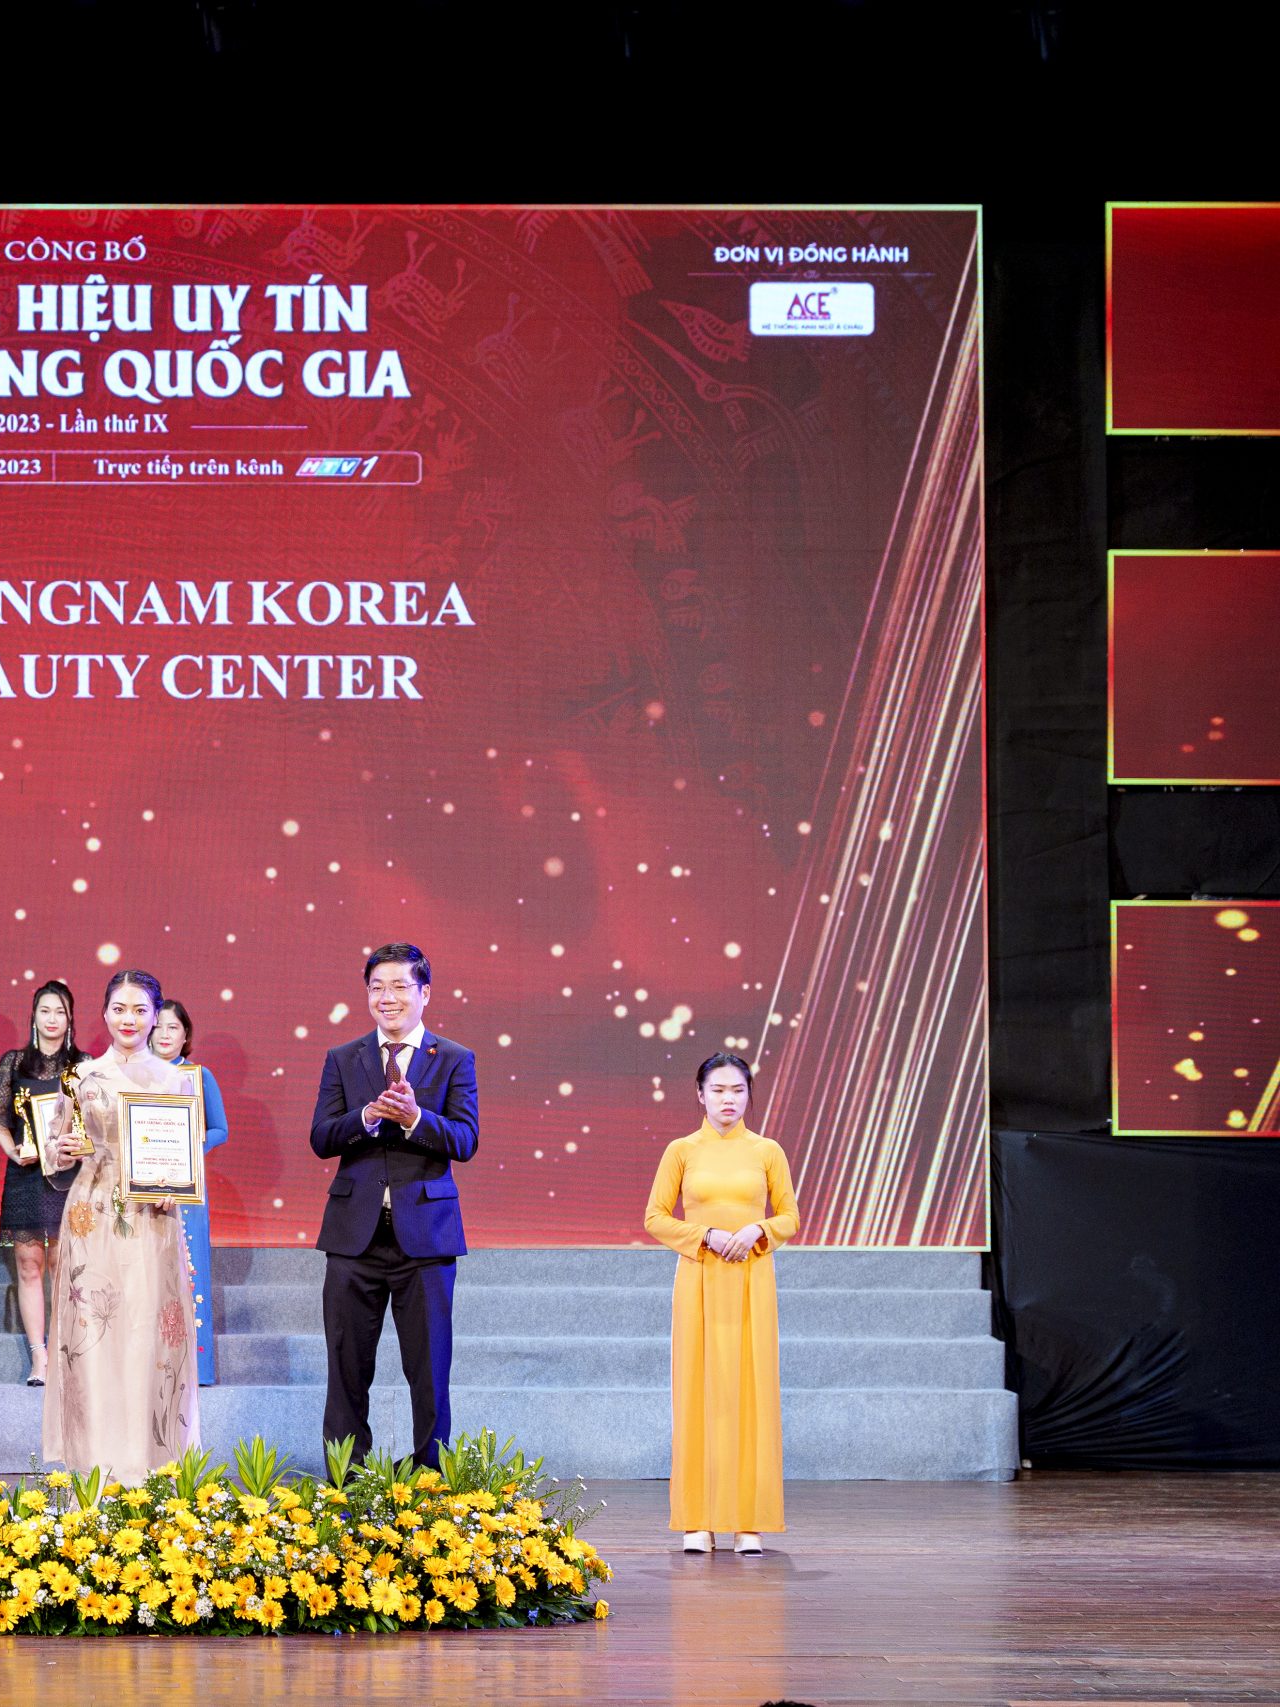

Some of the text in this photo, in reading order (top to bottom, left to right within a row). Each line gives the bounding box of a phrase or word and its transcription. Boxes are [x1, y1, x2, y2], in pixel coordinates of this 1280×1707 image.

[4, 236, 97, 262] CÔNG
[104, 235, 146, 262] BỐ
[714, 244, 760, 263] ĐƠN
[764, 246, 784, 266] VỊ
[852, 243, 909, 263] HÀNH
[17, 273, 152, 342] HIỆU
[172, 284, 251, 332] UY
[264, 274, 368, 332] TÍN
[787, 292, 830, 317] ACE
[104, 334, 284, 404] QUỐC
[302, 349, 412, 398] GIA
[60, 408, 98, 433] Lần
[104, 413, 139, 433] thứ
[144, 413, 169, 433] IX
[93, 458, 142, 478] Trực
[146, 455, 184, 479] tiếp
[190, 458, 230, 475] trên
[236, 458, 284, 475] kênh
[247, 580, 476, 626] KOREA
[161, 653, 424, 700] CENTER
